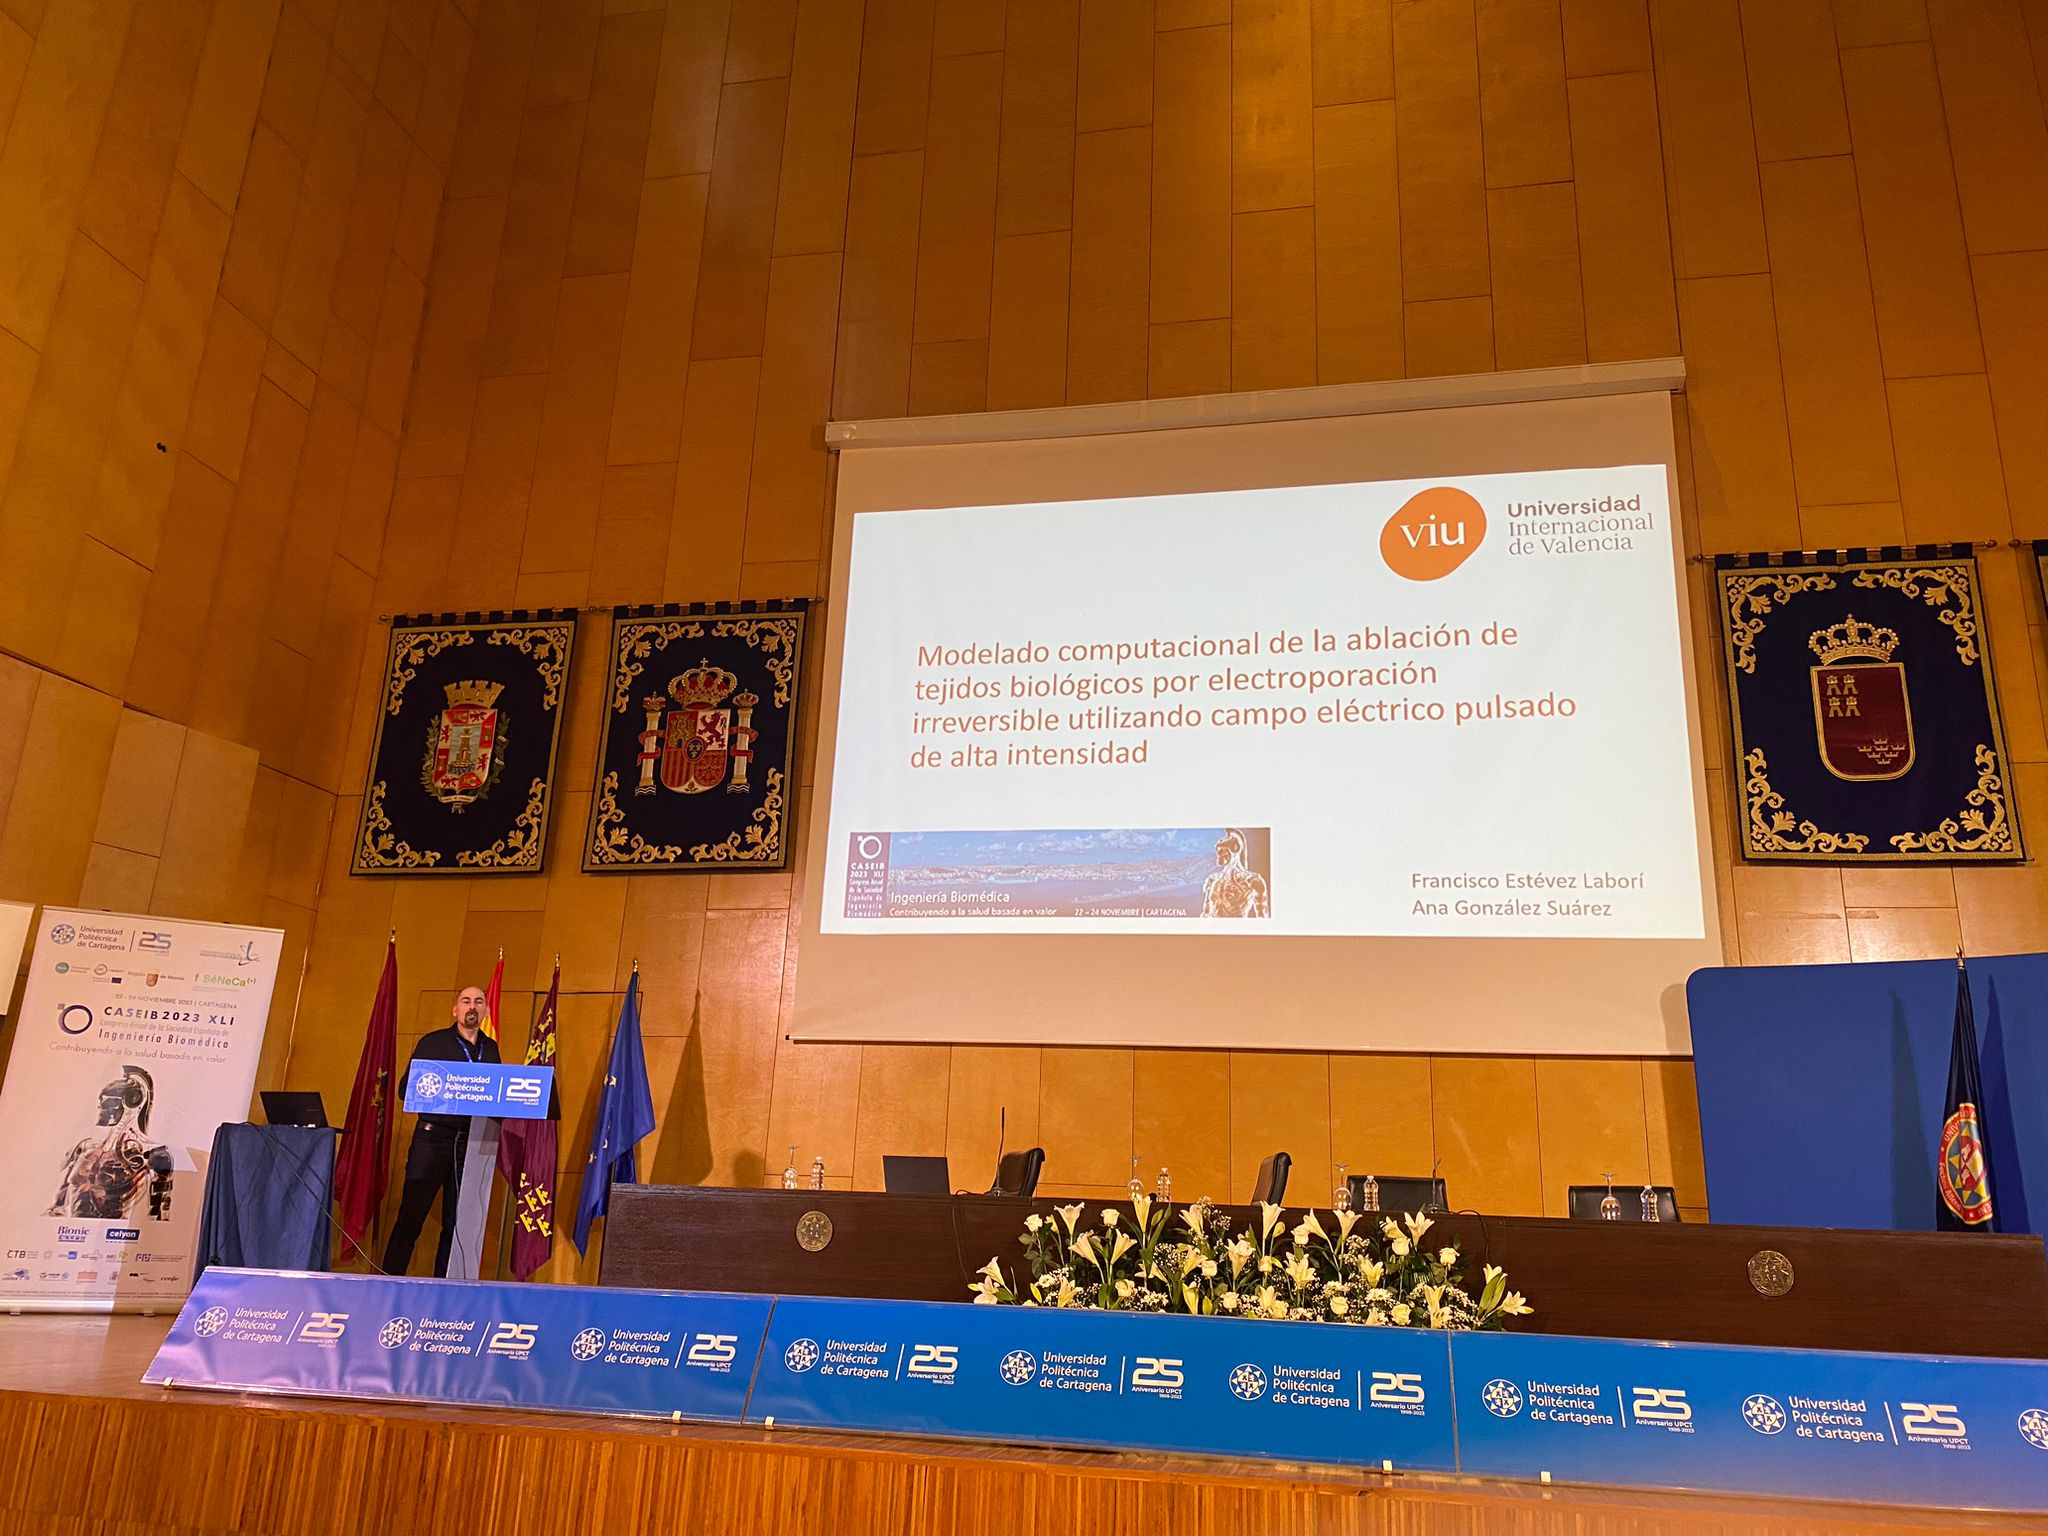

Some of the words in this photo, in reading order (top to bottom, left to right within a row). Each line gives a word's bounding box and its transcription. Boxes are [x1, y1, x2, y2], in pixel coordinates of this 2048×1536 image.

[1508, 494, 1640, 518] Universidad
[1400, 514, 1464, 548] viu
[1509, 513, 1653, 537] Internacional
[1509, 539, 1534, 556] de
[1540, 533, 1633, 554] Valencia
[918, 640, 1049, 667] Modelado
[1058, 631, 1259, 665] computacional
[1269, 630, 1303, 654] de
[1314, 629, 1336, 652] la
[1347, 623, 1471, 650] ablación
[1481, 621, 1518, 646] de
[915, 676, 1001, 705] tejidos
[1010, 672, 1143, 701] biológicos
[1153, 674, 1199, 698] por
[1208, 660, 1437, 694] electroporación
[913, 707, 1060, 734] irreversible
[1068, 703, 1201, 730] utilizando
[1211, 705, 1307, 731] campo
[1317, 697, 1445, 724] eléctrico
[1455, 691, 1576, 726] pulsado
[910, 745, 941, 768] de
[950, 743, 998, 768] alta
[1008, 739, 1148, 767] intensidad
[851, 862, 885, 870] CASEIB
[850, 870, 868, 878] 2023
[1412, 873, 1499, 889] Francisco
[1506, 872, 1577, 889] Estévez
[1583, 871, 1644, 889] Laborí
[890, 891, 947, 906] Ingeniería
[950, 890, 1010, 903] Biomédica
[889, 907, 949, 917] Contribuyendo
[958, 907, 966, 916] la
[967, 907, 990, 916] salud
[991, 907, 1020, 916] basada
[1035, 907, 1058, 916] valor
[1100, 908, 1139, 916] NOVIEMBRE
[1145, 908, 1187, 916] CARTAGENA
[1412, 900, 1448, 916] Ana
[1455, 898, 1541, 916] González
[1547, 899, 1612, 916] Suárez
[79, 933, 117, 943] Politécnica
[80, 926, 123, 936] Universidad
[88, 940, 125, 951] Cartagena
[139, 931, 172, 950] 25
[198, 1000, 237, 1009] CARTAGENA
[208, 1015, 235, 1026] XLI
[99, 1029, 161, 1043] Ingeniería
[168, 1034, 229, 1048] Biomédica
[49, 1041, 113, 1056] Contribuyendo
[124, 1046, 132, 1056] la
[134, 1047, 158, 1058] salud
[160, 1050, 190, 1060] basada
[205, 1055, 226, 1064] valor
[446, 1074, 491, 1084] Universidad
[445, 1082, 485, 1093] Politécnica
[506, 1077, 541, 1098] 25
[455, 1092, 493, 1102] Cartagena
[57, 1226, 90, 1235] Bionic
[7, 1250, 26, 1259] CTB
[235, 1308, 289, 1320] Universidad
[228, 1318, 276, 1331] Politécnica
[300, 1312, 349, 1339] 25
[419, 1318, 475, 1331] Universidad
[223, 1330, 234, 1339] de
[237, 1330, 282, 1344] Cartagena
[414, 1330, 464, 1342] Politécnica
[489, 1322, 539, 1350] 25
[613, 1329, 671, 1342] Universidad
[409, 1341, 421, 1351] de
[424, 1342, 471, 1355] Cartagena
[608, 1341, 660, 1353] Politécnica
[688, 1333, 738, 1361] 25
[826, 1339, 887, 1353] Universidad
[604, 1353, 617, 1363] de
[619, 1353, 669, 1367] Cartagena
[823, 1352, 878, 1365] Politécnica
[908, 1344, 959, 1373] 25
[1043, 1351, 1107, 1365] Universidad
[820, 1365, 834, 1375] de
[836, 1365, 889, 1379] Cartagena
[1041, 1364, 1099, 1377] Politécnica
[1132, 1357, 1184, 1388] 25
[1273, 1365, 1341, 1380] Universidad
[1039, 1377, 1053, 1388] de
[1056, 1378, 1112, 1393] Cartagena
[1131, 1386, 1165, 1394] Aniversario
[1273, 1379, 1335, 1393] Politécnica
[1370, 1371, 1425, 1403] 25
[1527, 1380, 1600, 1396] Universidad
[1273, 1392, 1287, 1403] de
[1290, 1393, 1350, 1409] Cartagena
[1370, 1402, 1406, 1410] Aniversario
[1529, 1394, 1595, 1410] Politécnica
[1632, 1387, 1692, 1421] 25
[1789, 1396, 1867, 1413] Universidad
[1530, 1408, 1547, 1420] de
[1549, 1409, 1613, 1426] Cartagena
[1635, 1418, 1673, 1427] Aniversario
[1792, 1410, 1863, 1427] Politécnica
[1901, 1402, 1966, 1437] 25
[1796, 1425, 1813, 1438] de
[1815, 1426, 1885, 1443] Cartagena
[1908, 1435, 1948, 1444] Aniversario
